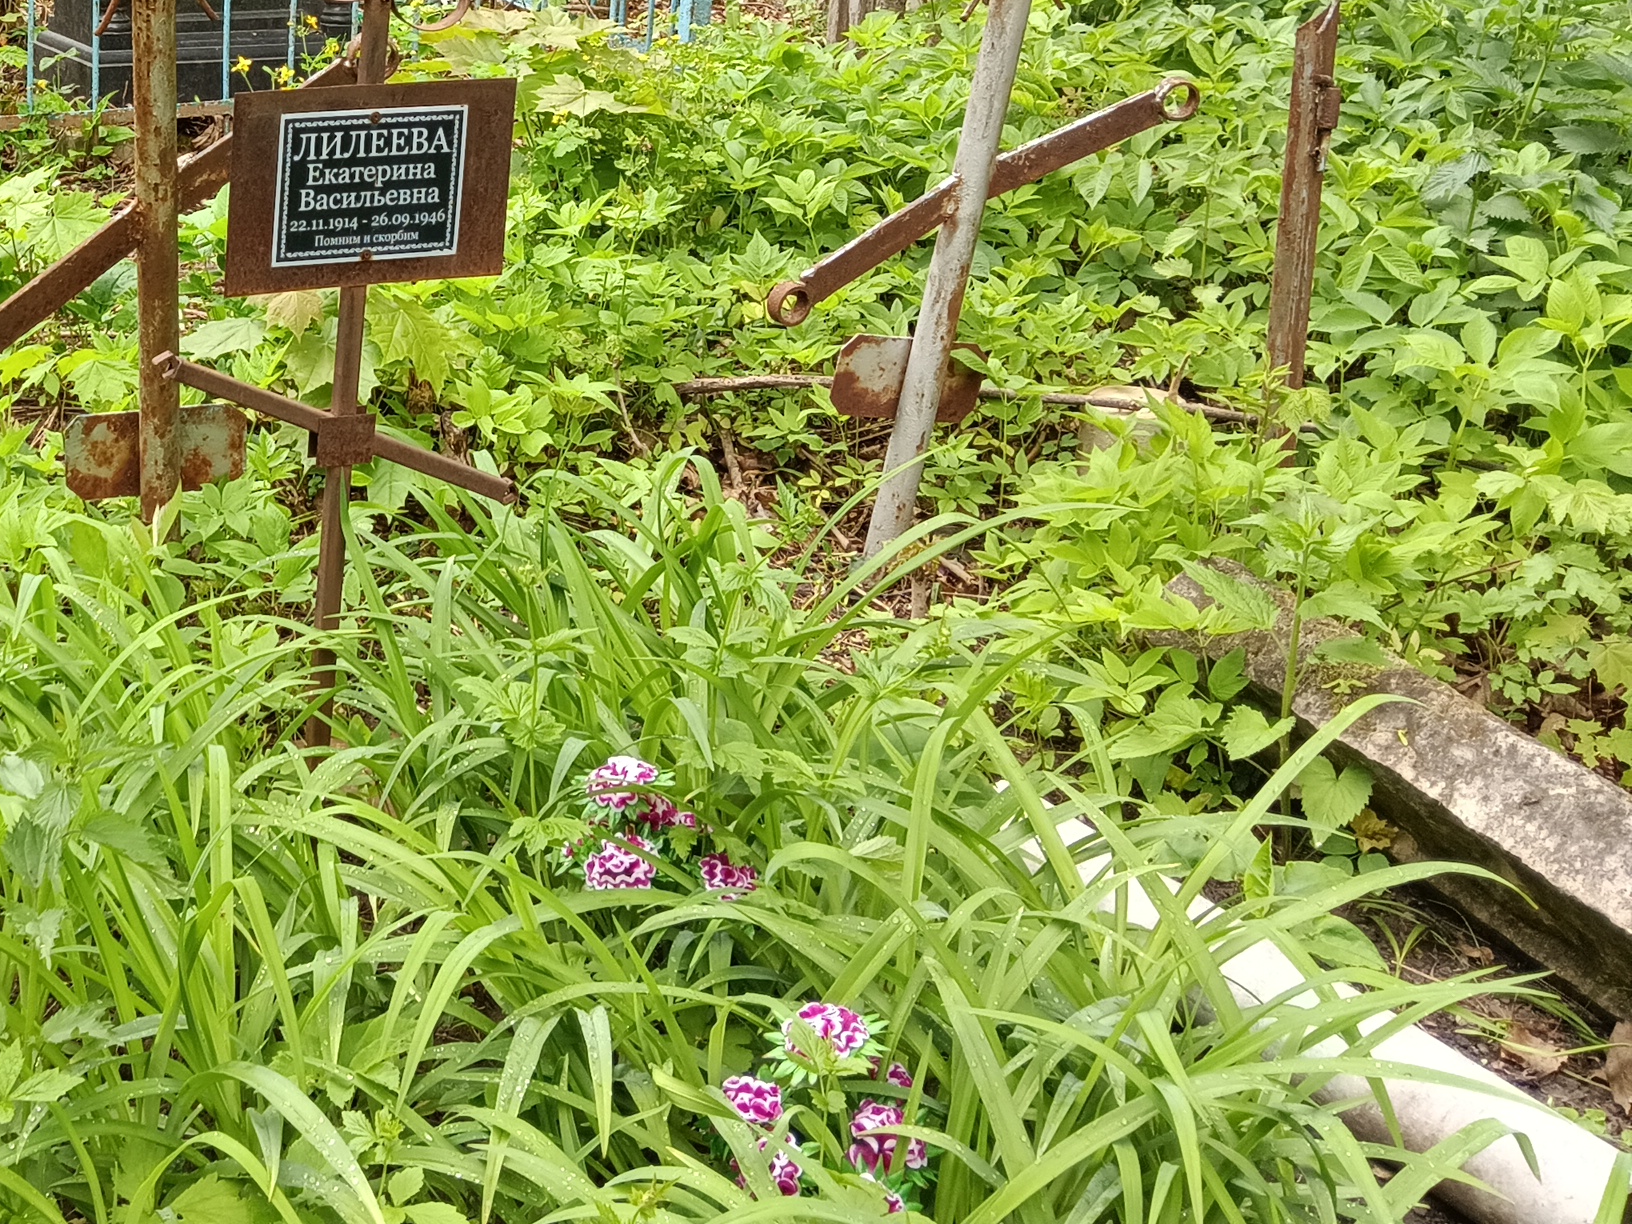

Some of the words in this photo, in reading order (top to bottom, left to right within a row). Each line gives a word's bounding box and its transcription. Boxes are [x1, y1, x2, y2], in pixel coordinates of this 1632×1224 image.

[293, 126, 451, 161] ЛИЛЕЕВА
[306, 162, 436, 188] Екатерина
[298, 186, 440, 212] Васильевна
[290, 216, 358, 232] 22.11.1914
[370, 209, 445, 227] 26.09.1946
[314, 234, 361, 247] Помним
[363, 234, 371, 244] и
[372, 229, 419, 245] скорбим
